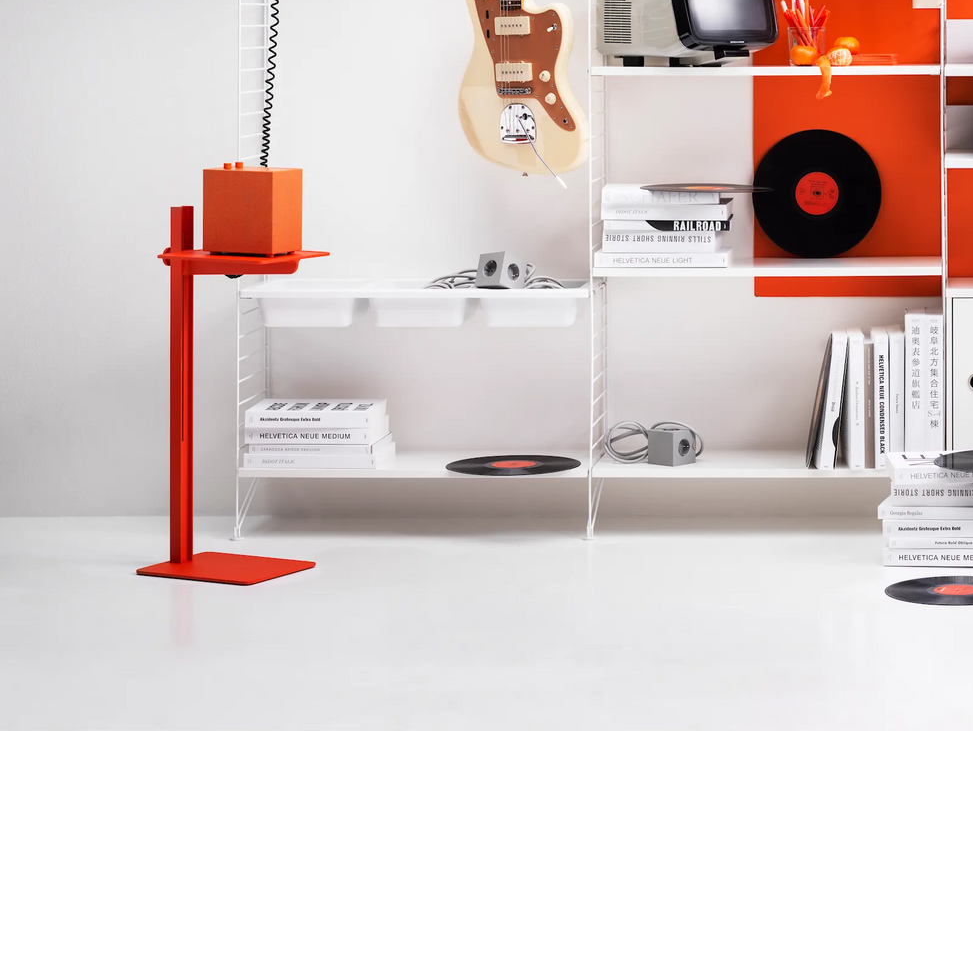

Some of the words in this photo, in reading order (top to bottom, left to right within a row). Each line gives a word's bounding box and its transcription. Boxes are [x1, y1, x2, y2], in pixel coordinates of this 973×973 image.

[673, 221, 722, 231] RAILROAD
[605, 234, 629, 242] STORIE
[632, 234, 654, 242] SHORT
[688, 235, 712, 243] STILLS
[894, 488, 919, 496] STORIE
[922, 489, 944, 497] SHORT
